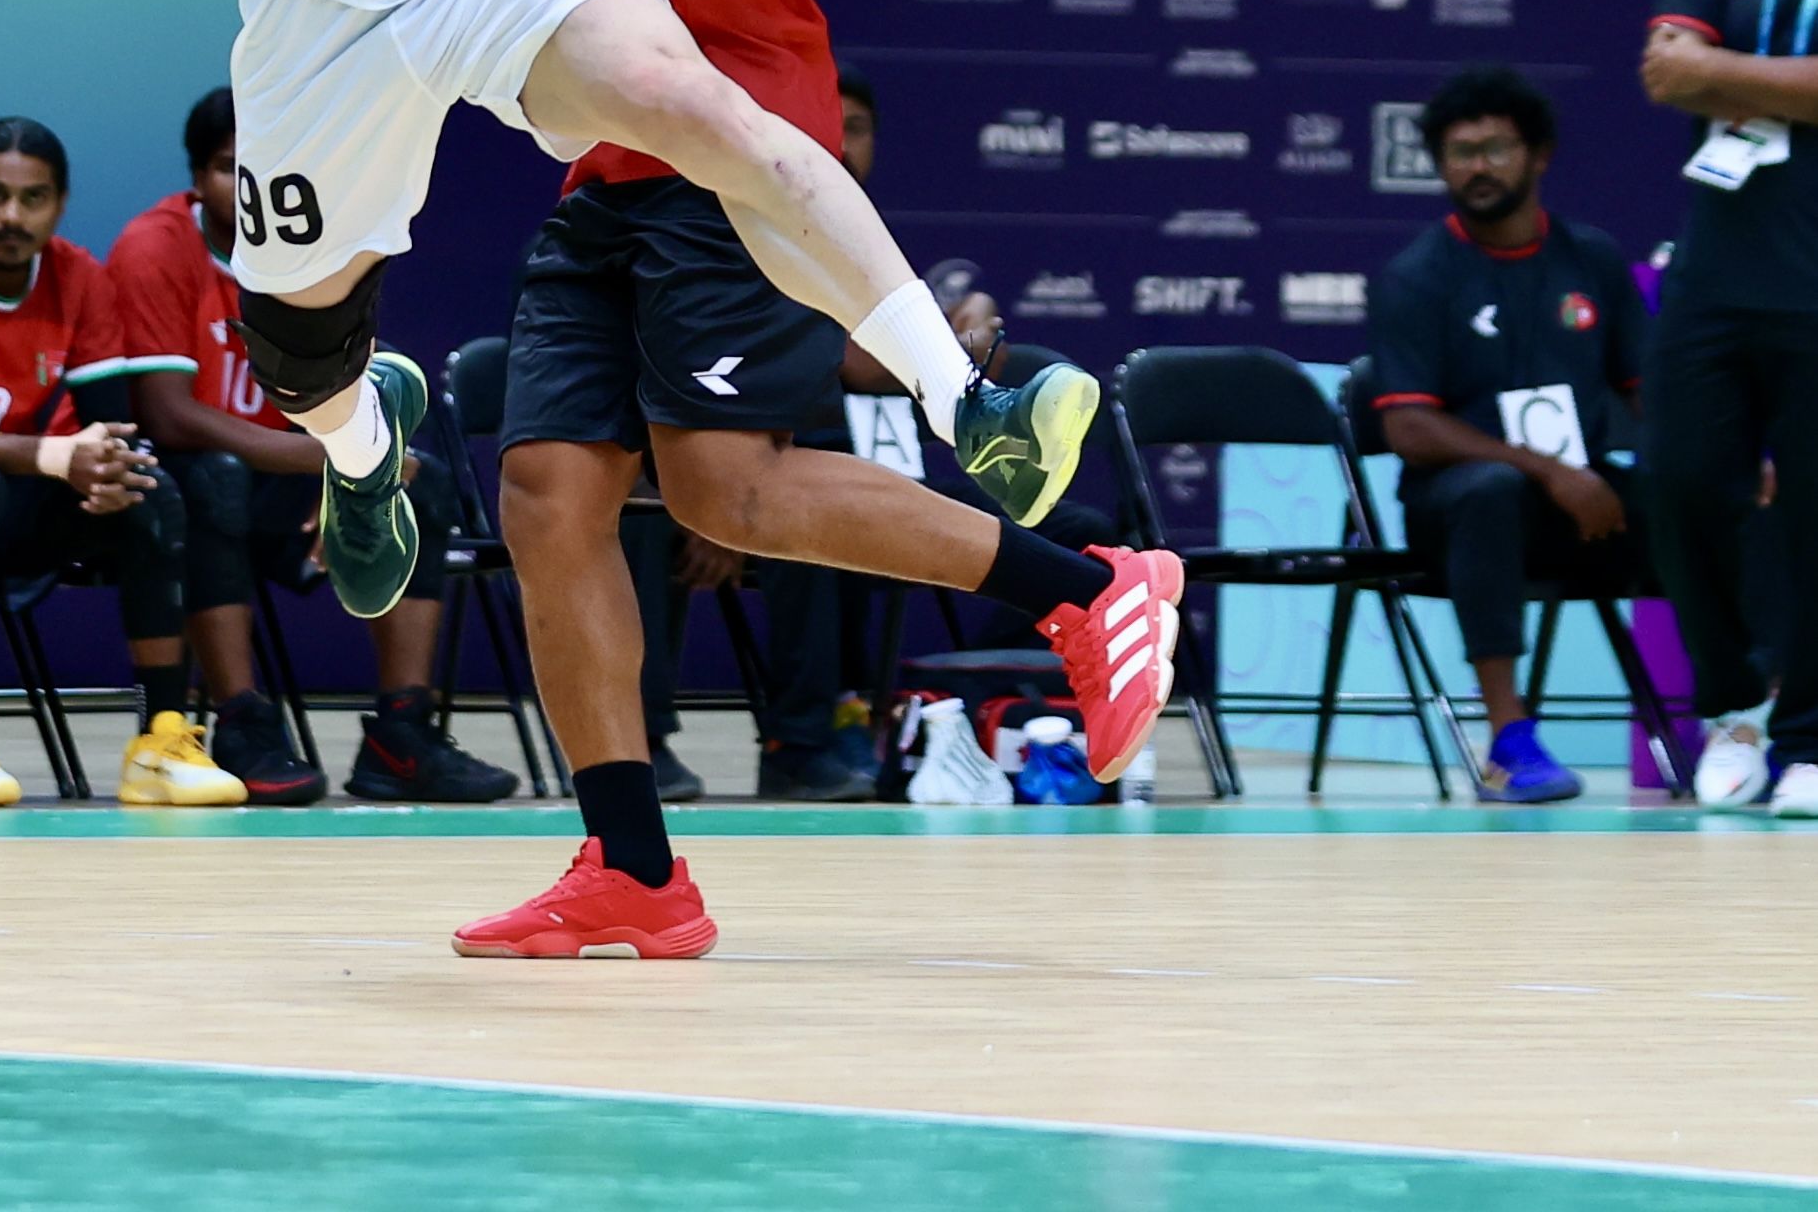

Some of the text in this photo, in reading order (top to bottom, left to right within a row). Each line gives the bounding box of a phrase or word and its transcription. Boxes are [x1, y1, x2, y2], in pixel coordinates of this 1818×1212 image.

[238, 164, 323, 246] 99
[869, 401, 911, 464] A
[1519, 396, 1571, 458] C
